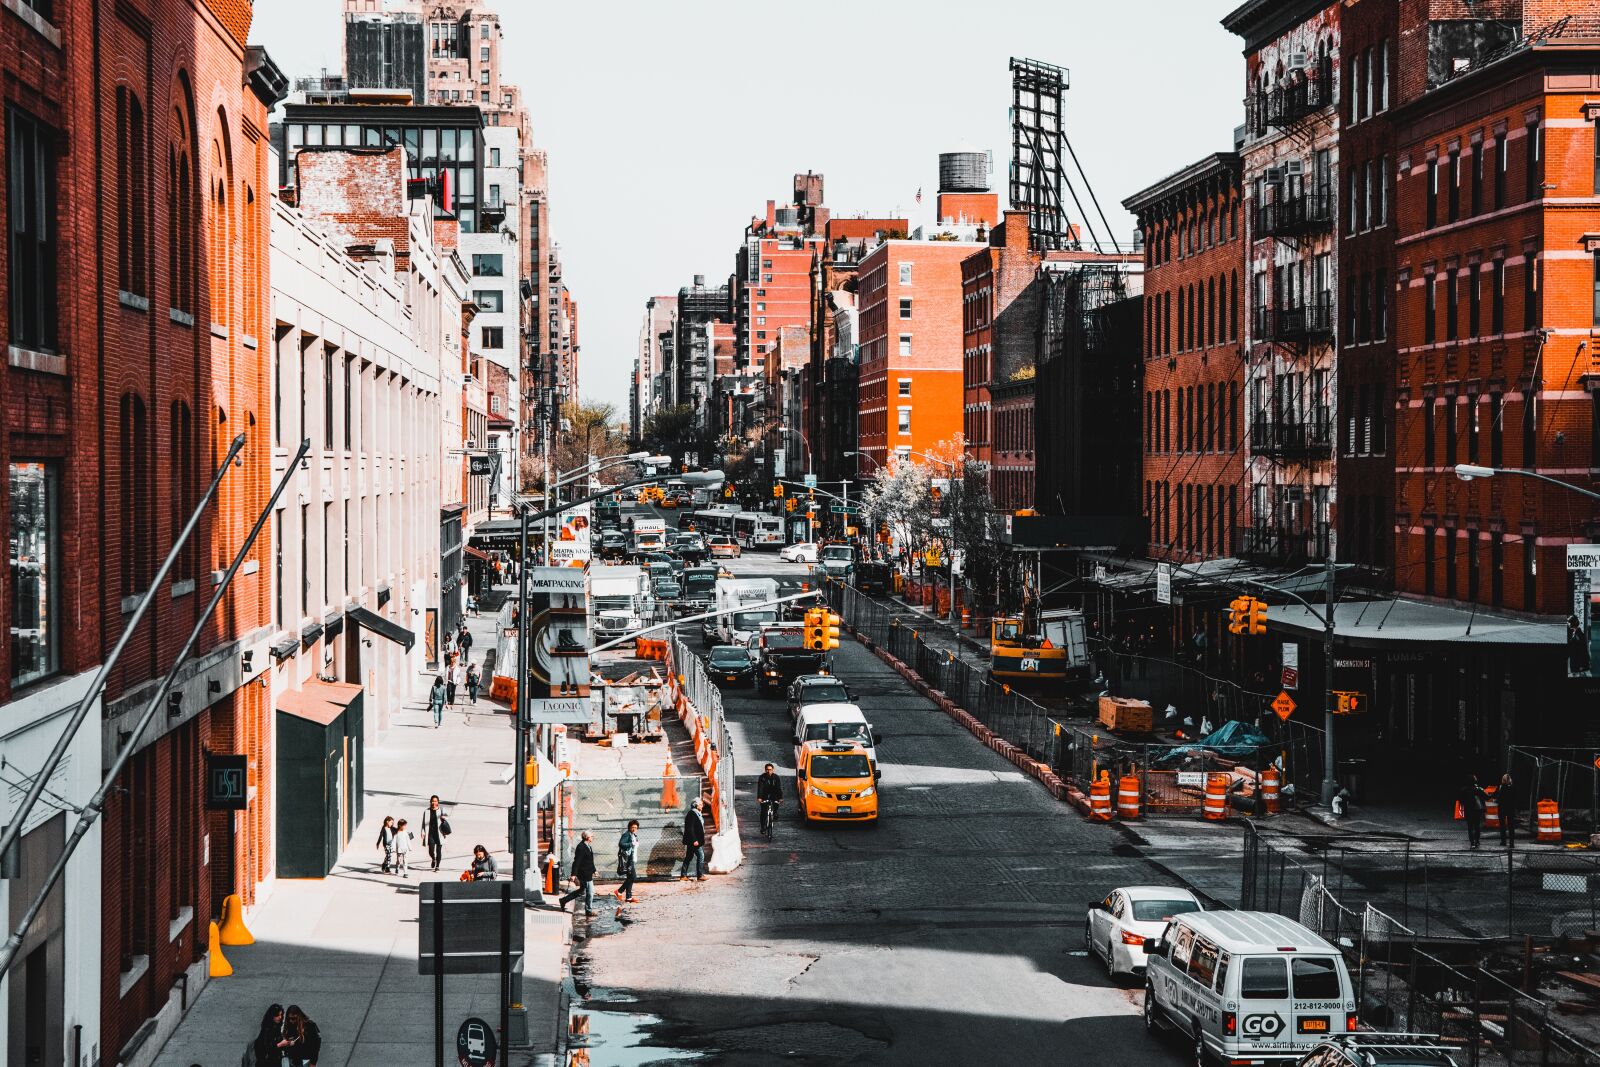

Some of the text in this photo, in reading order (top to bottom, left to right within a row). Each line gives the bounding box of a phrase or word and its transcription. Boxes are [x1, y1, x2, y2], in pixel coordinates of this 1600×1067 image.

[533, 580, 584, 588] MEATPACKING
[1020, 658, 1041, 671] CAT
[1334, 660, 1370, 668] WASHINGTON ST
[541, 701, 581, 710] TACONIC
[1196, 1000, 1219, 1025] SHUTTLE
[1245, 1016, 1279, 1033] GO
